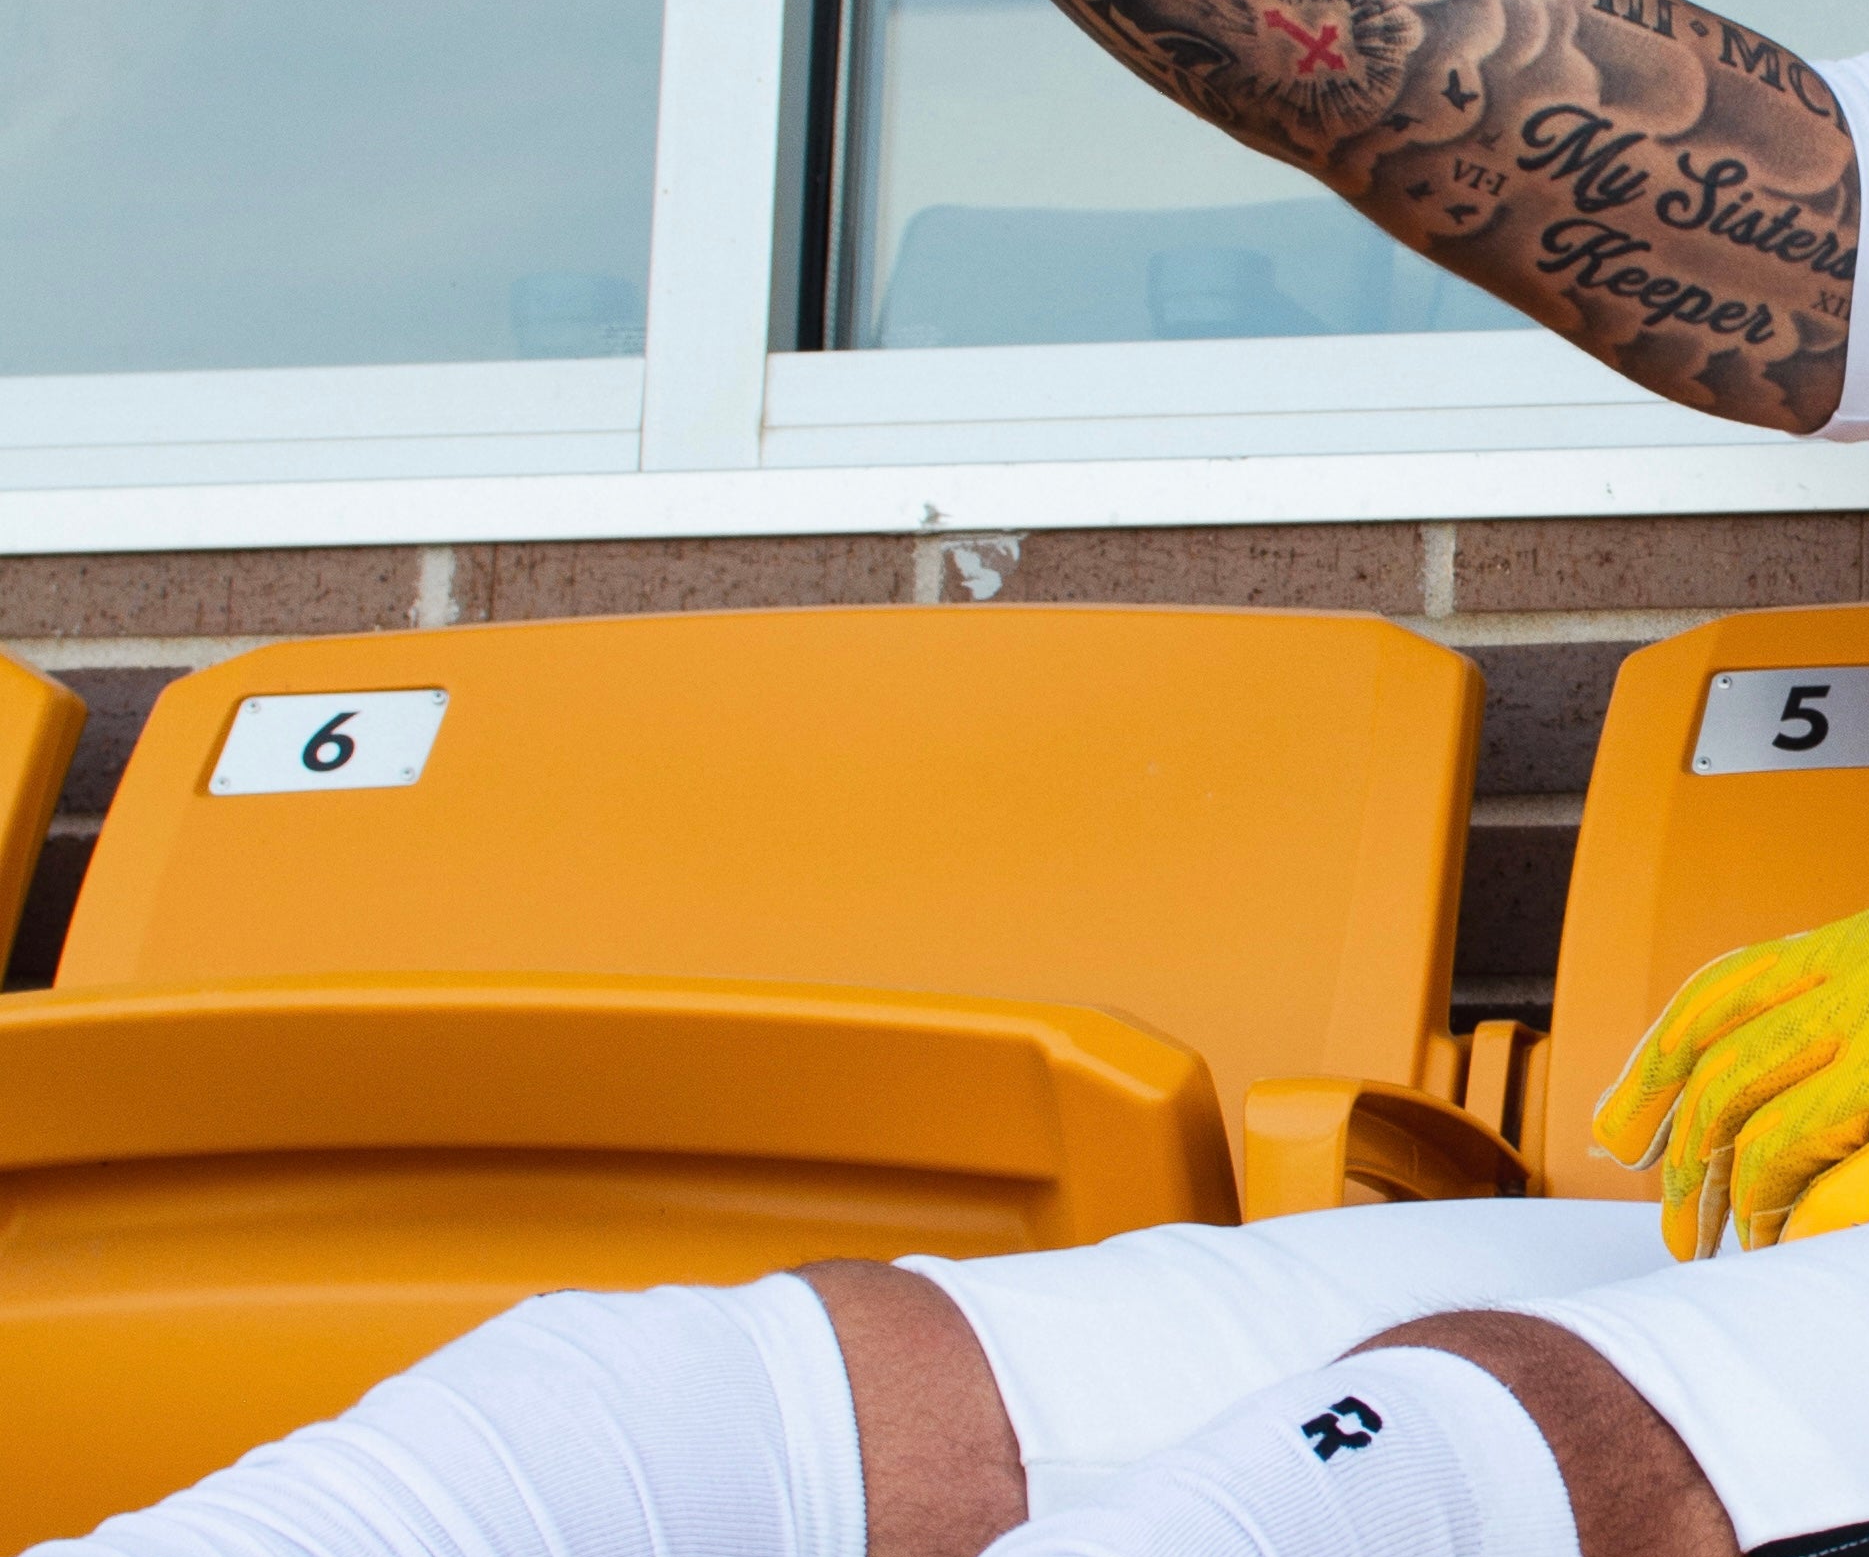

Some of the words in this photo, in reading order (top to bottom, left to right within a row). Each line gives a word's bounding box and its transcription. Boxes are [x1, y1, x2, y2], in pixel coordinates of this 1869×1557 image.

[1516, 104, 1650, 213] My
[1655, 151, 1858, 281] Sisters
[1536, 217, 1776, 344] Keeper
[302, 710, 361, 772] 6
[1771, 685, 1832, 752] 5
